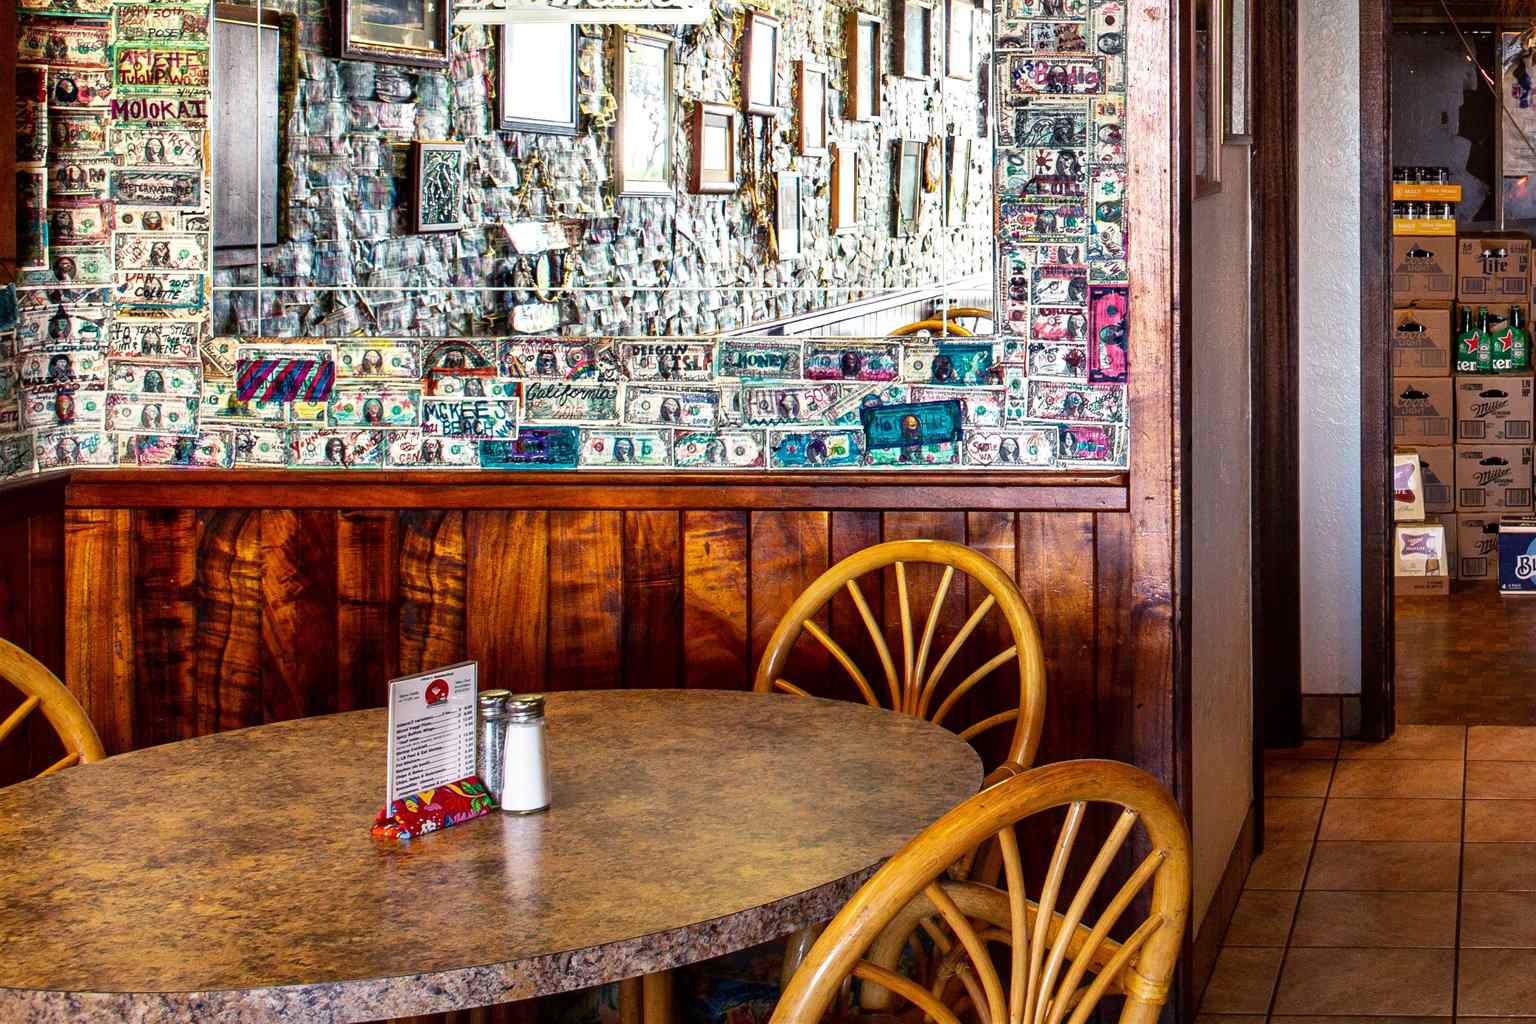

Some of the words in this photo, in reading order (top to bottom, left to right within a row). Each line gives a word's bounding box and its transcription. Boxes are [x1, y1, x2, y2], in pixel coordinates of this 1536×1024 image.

[1479, 256, 1509, 276] Lite
[527, 382, 617, 405] California
[1471, 399, 1510, 418] Miller
[442, 419, 494, 436] BEACH
[1473, 468, 1512, 486] Miller
